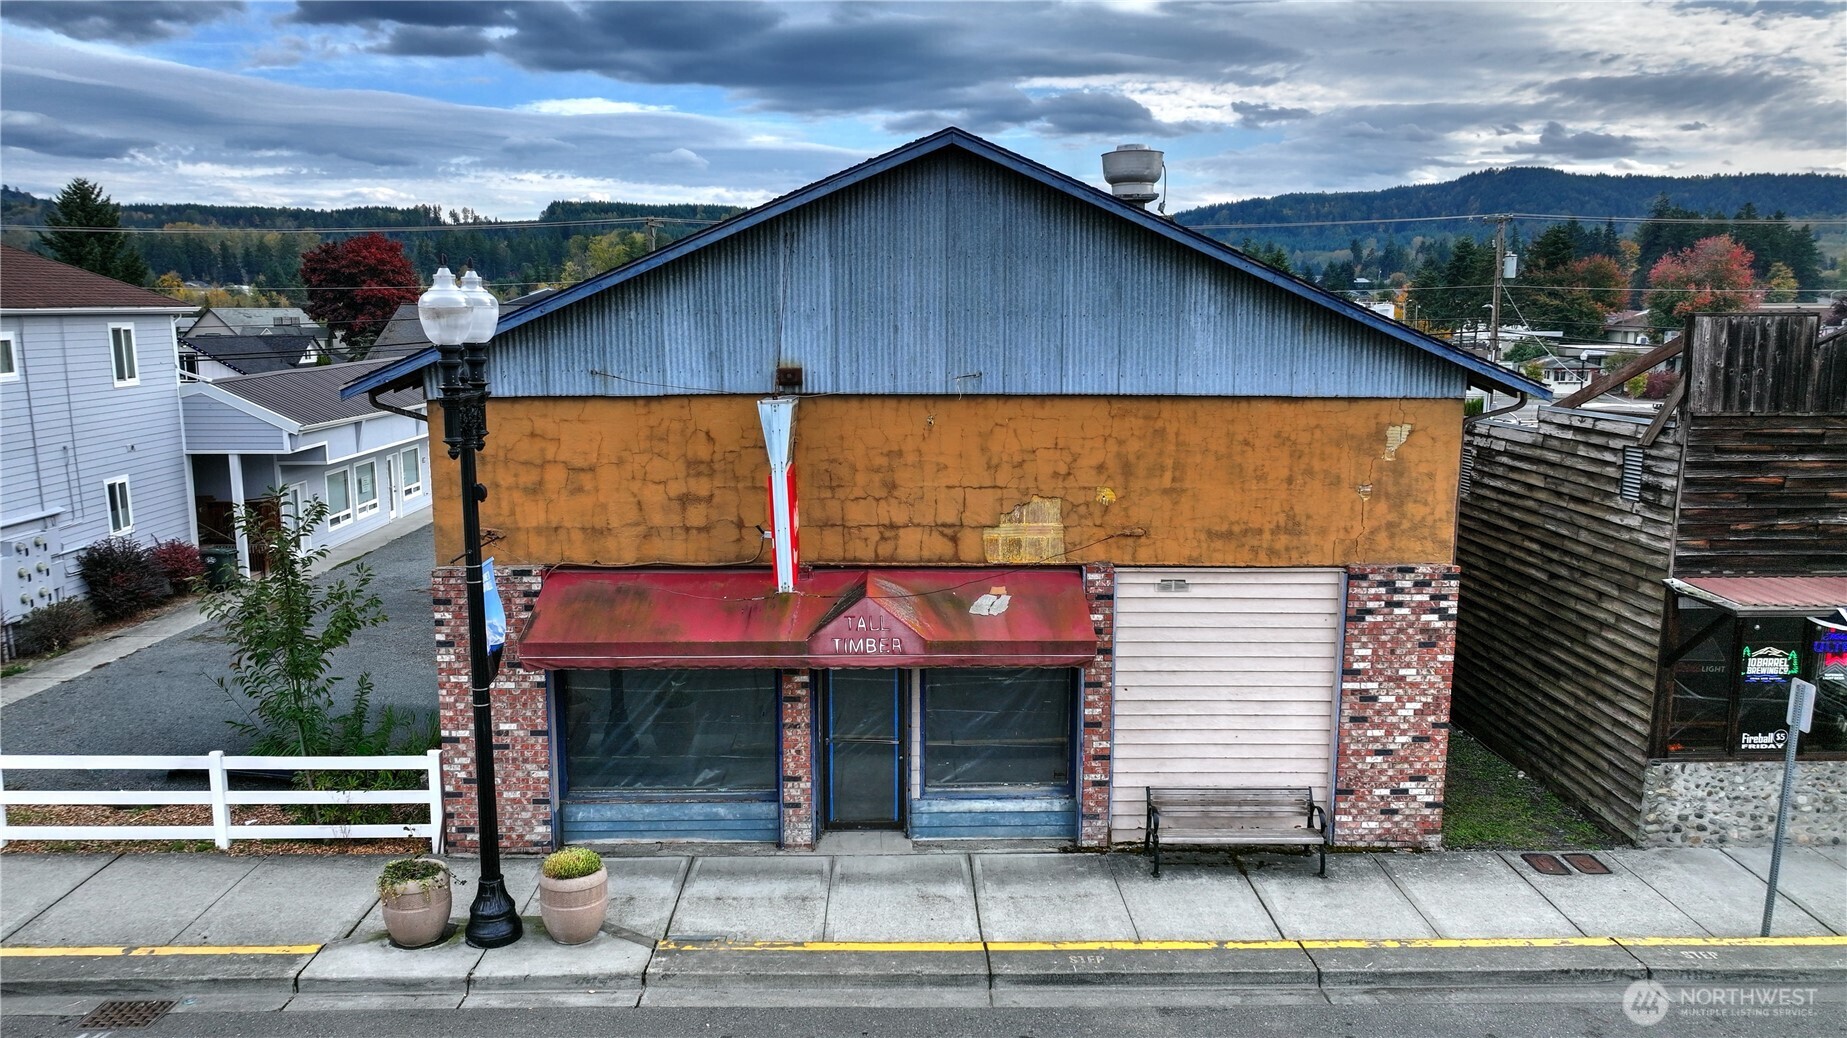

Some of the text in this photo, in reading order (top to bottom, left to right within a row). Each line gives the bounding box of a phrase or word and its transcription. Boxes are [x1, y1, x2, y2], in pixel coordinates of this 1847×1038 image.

[844, 615, 891, 631] TALL
[832, 637, 902, 654] TIMBER
[1757, 657, 1789, 667] BARREL
[1701, 665, 1726, 673] LIGHT
[1746, 666, 1779, 675] BREWING
[1741, 732, 1774, 744] Fireball
[1775, 733, 1786, 741] $5
[1069, 955, 1105, 964] STEP
